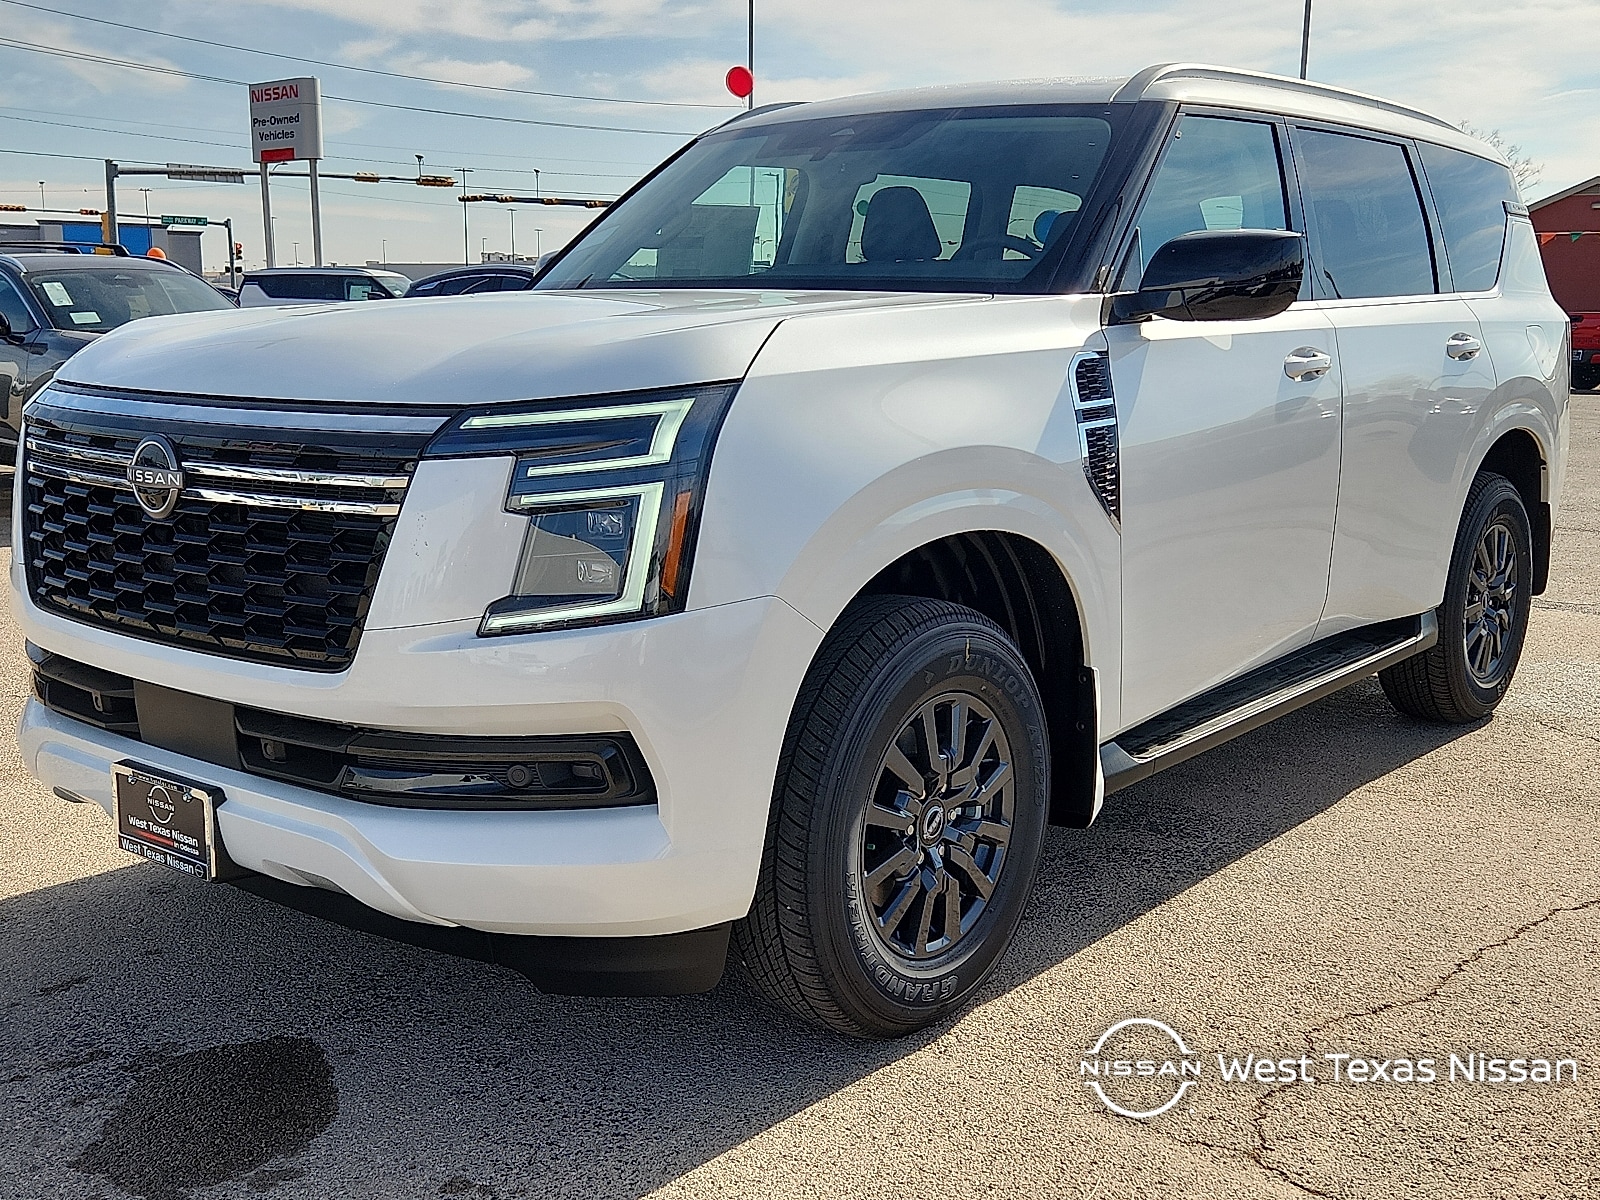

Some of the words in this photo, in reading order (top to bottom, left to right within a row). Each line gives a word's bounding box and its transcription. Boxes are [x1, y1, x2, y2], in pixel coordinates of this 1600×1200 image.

[251, 84, 299, 103] NISSAN
[252, 113, 300, 127] Pre-Owned
[258, 130, 295, 141] Vehicles
[126, 468, 180, 486] NISSAN
[946, 653, 1031, 708] DUNLOP
[147, 797, 175, 812] NISSAN
[128, 814, 148, 830] West
[148, 822, 171, 837] Texas
[172, 829, 198, 847] Nissan
[121, 837, 141, 855] West
[142, 845, 165, 863] Texas
[166, 853, 195, 874] Nissan
[845, 871, 959, 1001] GRANDTREK
